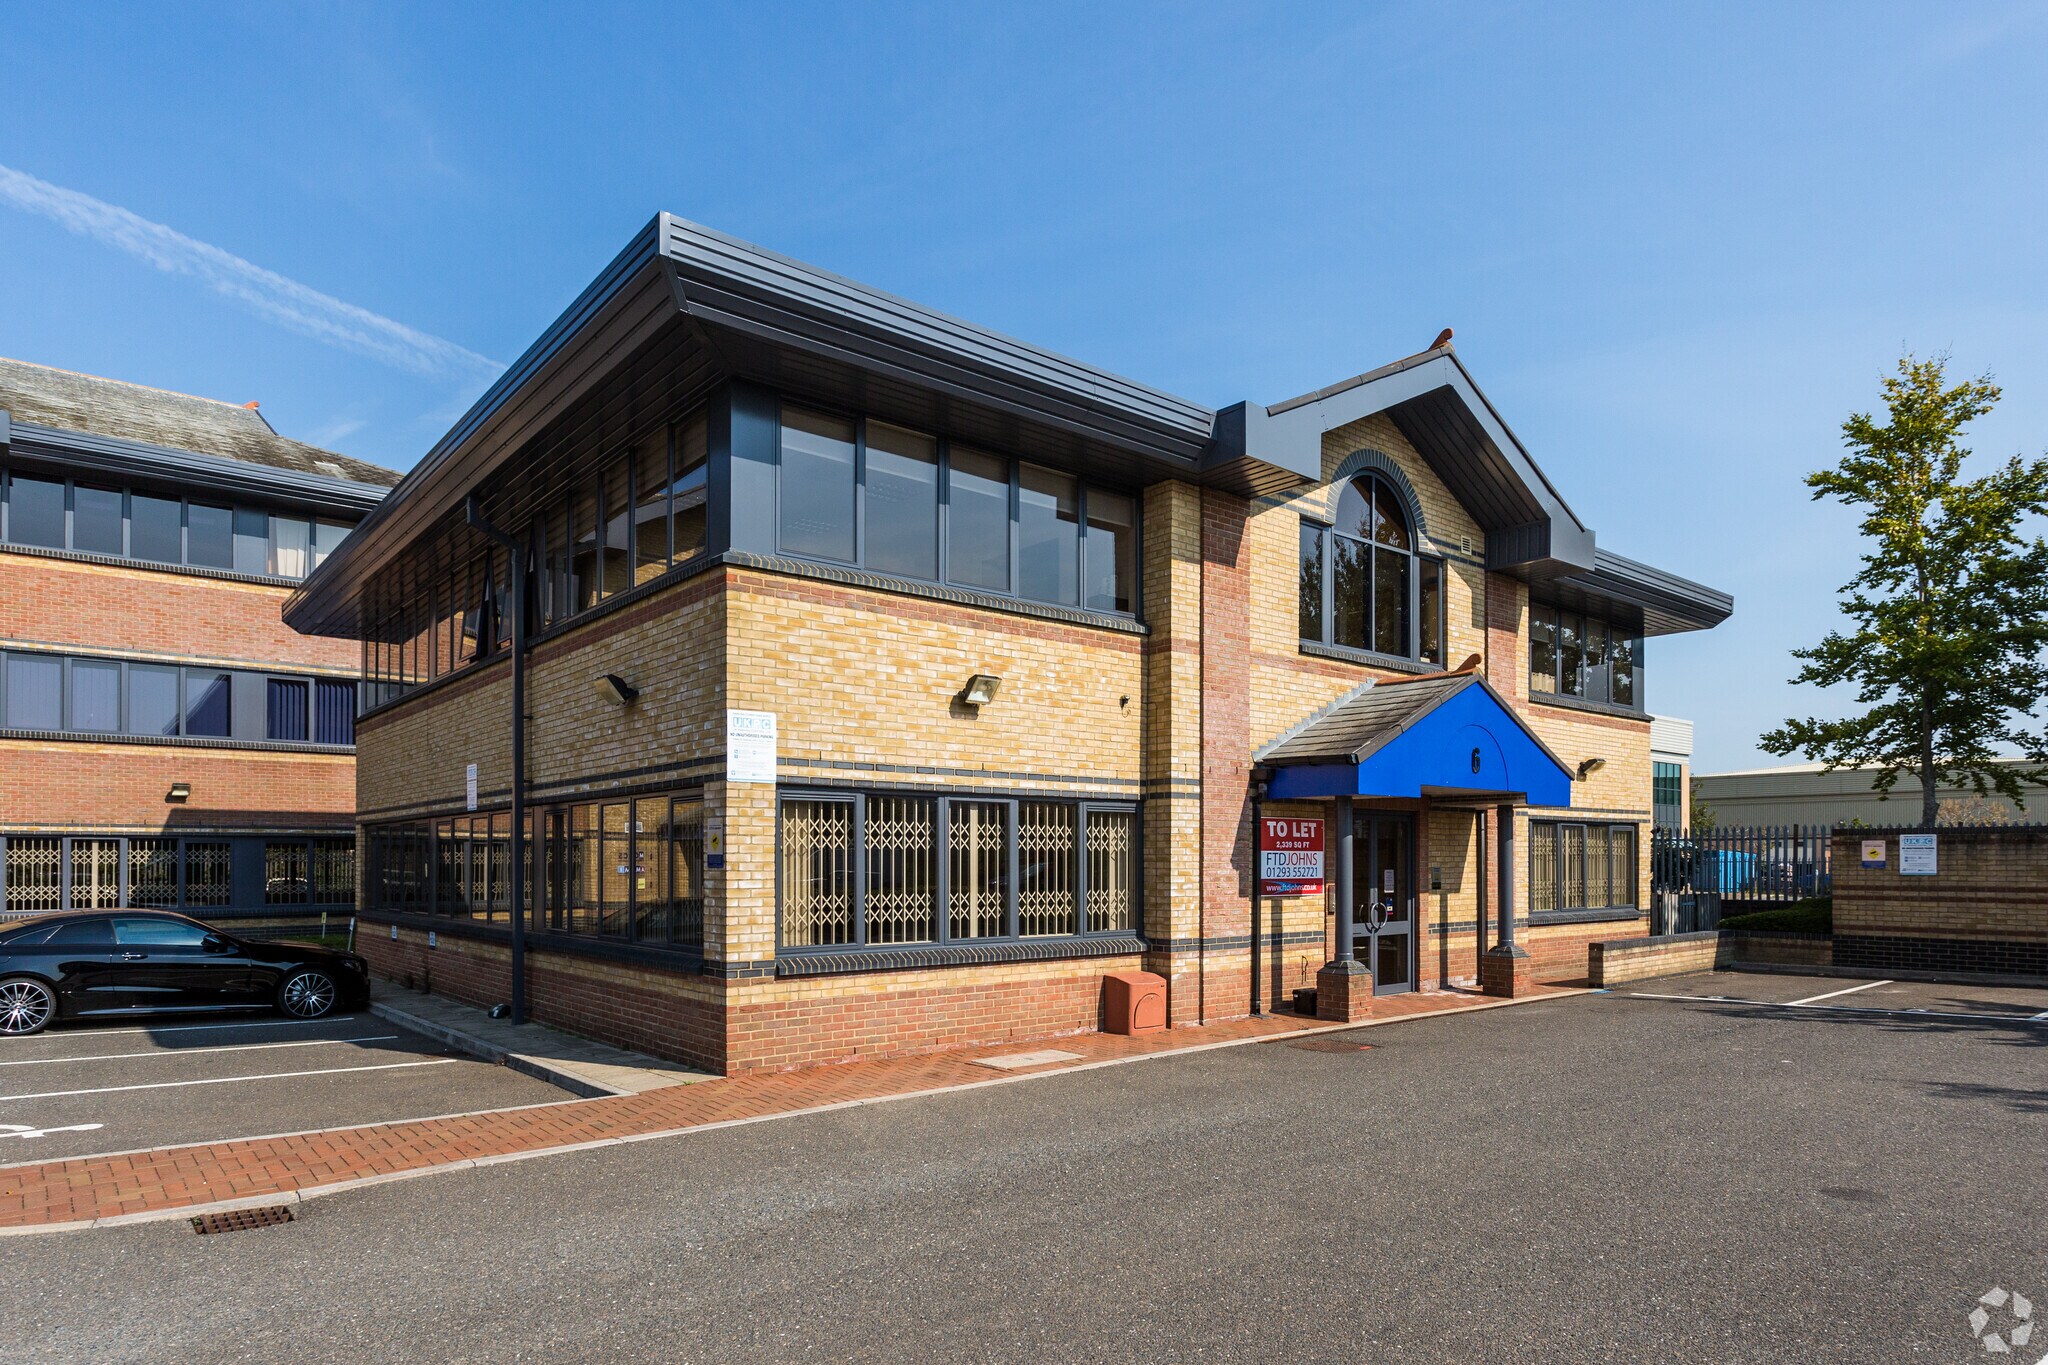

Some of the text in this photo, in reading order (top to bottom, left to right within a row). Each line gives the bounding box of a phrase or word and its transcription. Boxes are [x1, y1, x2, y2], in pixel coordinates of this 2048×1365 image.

[733, 717, 771, 729] UKPC
[1471, 747, 1481, 774] 6
[1266, 821, 1317, 838] TO LET
[1276, 841, 1293, 849] 2,339
[1293, 841, 1302, 849] SQ
[1266, 852, 1318, 866] FTDJOHNS
[1266, 867, 1318, 878] 01293 552721
